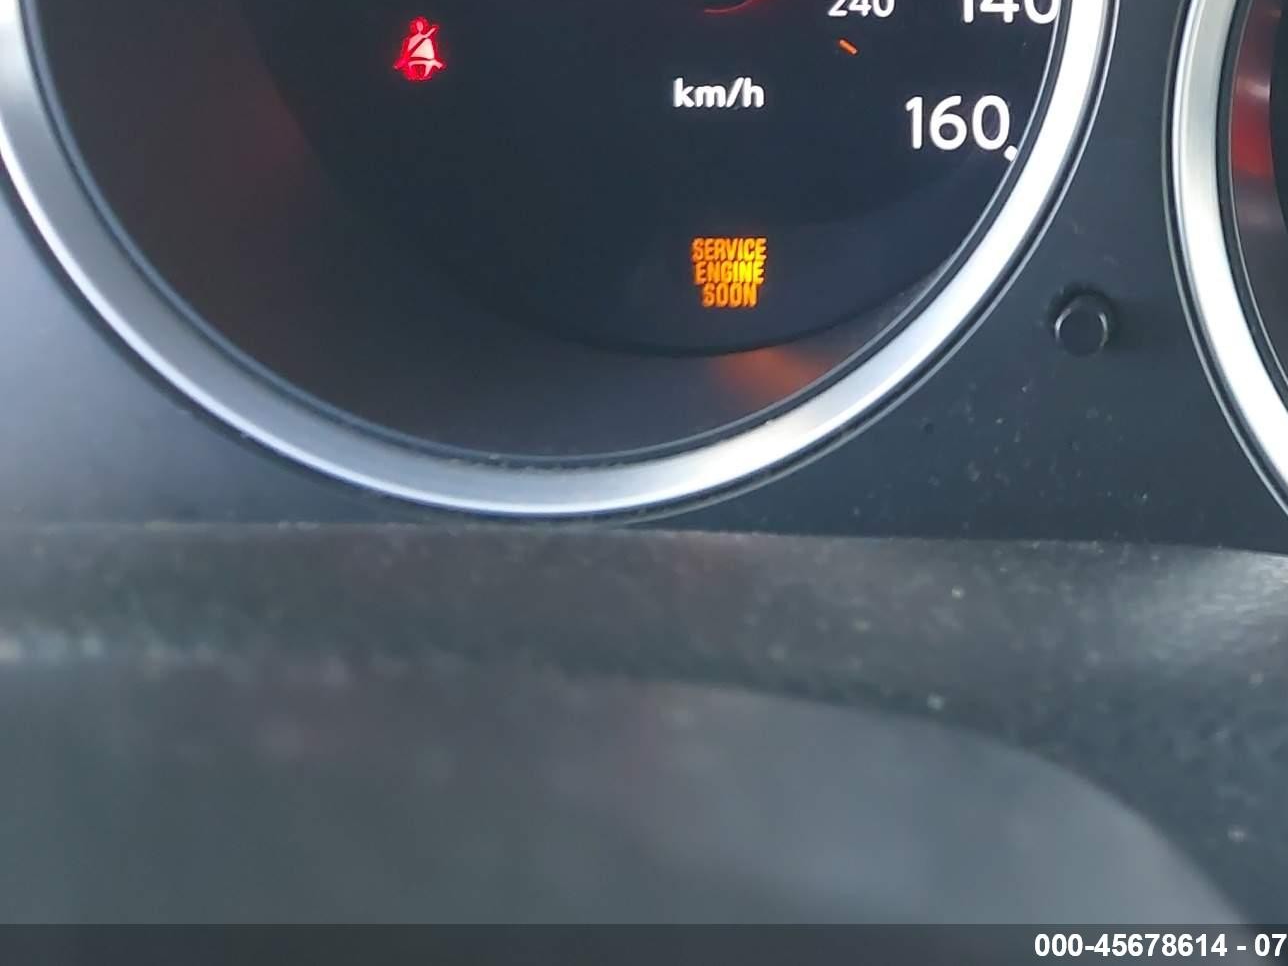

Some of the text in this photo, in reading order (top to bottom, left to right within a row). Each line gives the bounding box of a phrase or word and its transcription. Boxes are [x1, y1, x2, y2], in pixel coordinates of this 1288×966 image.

[674, 78, 764, 109] km/h
[906, 96, 1009, 150] 160
[692, 237, 767, 262] SERVICE
[695, 261, 765, 285] ENGINE
[702, 283, 758, 307] SOON
